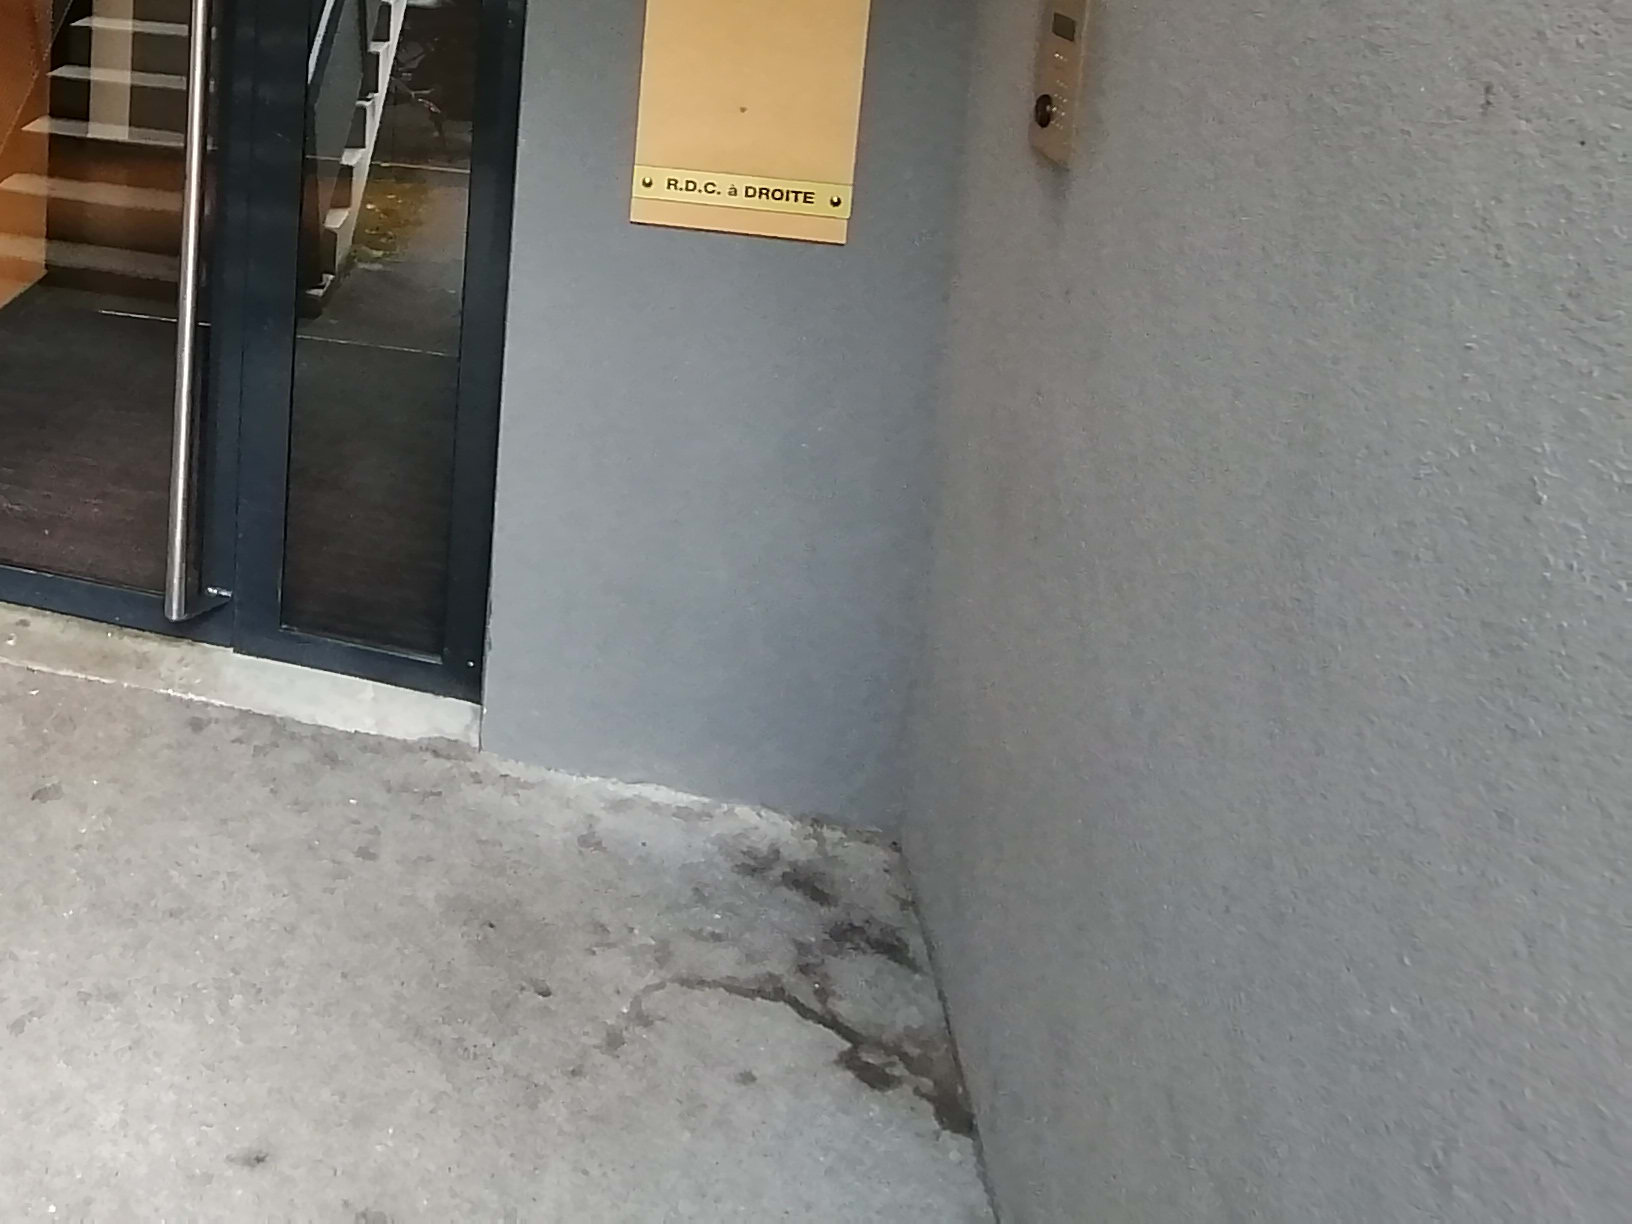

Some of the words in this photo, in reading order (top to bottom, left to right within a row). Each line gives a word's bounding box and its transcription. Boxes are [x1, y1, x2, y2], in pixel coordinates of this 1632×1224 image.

[666, 178, 721, 196] R.D.C.
[727, 183, 738, 197] à
[744, 186, 816, 204] DROITE
